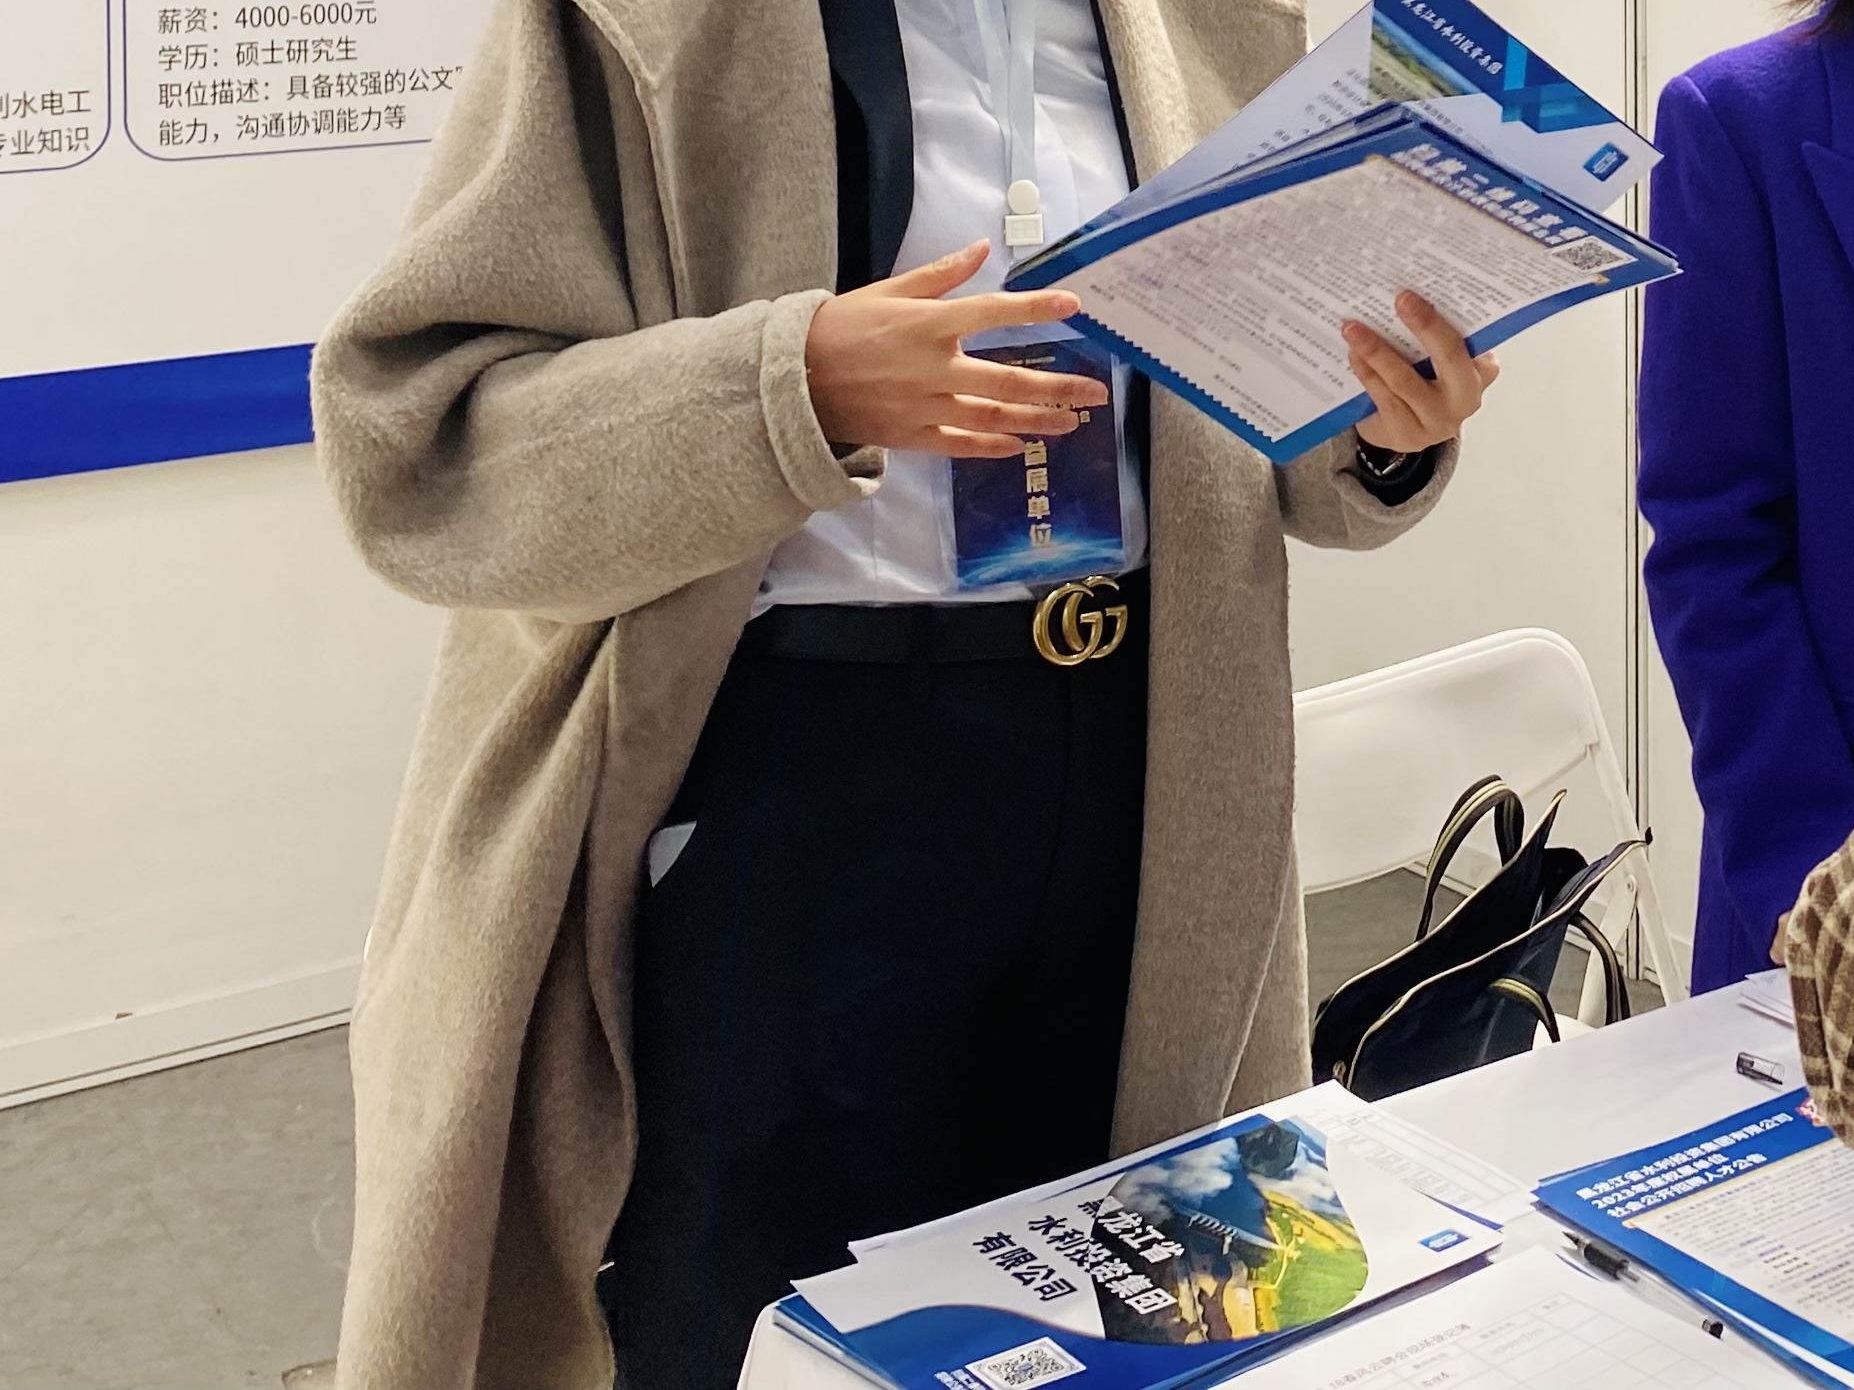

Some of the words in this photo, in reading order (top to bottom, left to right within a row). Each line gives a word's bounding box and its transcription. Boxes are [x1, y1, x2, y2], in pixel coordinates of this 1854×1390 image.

[157, 65, 464, 109] 职位描述：具备较强的公文
[1077, 1195, 1185, 1264] 黑龙江省
[972, 1230, 1079, 1302] 有限公司
[1027, 1214, 1178, 1316] 水利投资集团
